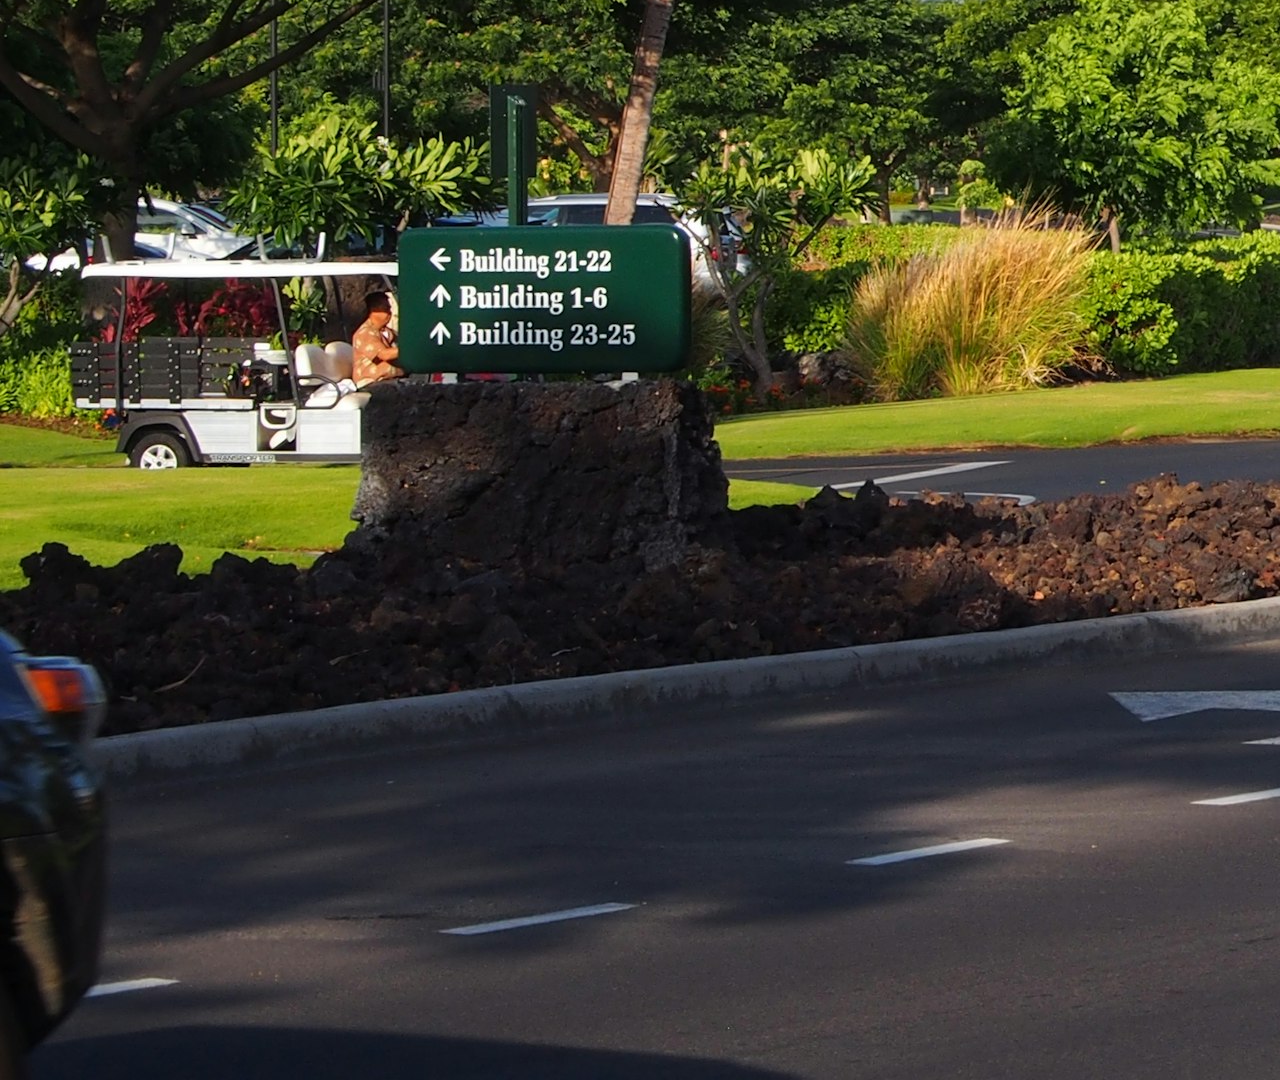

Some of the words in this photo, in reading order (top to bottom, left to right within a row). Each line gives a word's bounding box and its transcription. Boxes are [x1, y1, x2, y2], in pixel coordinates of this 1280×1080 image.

[459, 247, 549, 278] Building
[554, 249, 612, 272] 21-22
[459, 284, 564, 314] Building
[570, 286, 608, 309] 1-6
[459, 321, 564, 351] Building
[570, 324, 636, 345] 23-25
